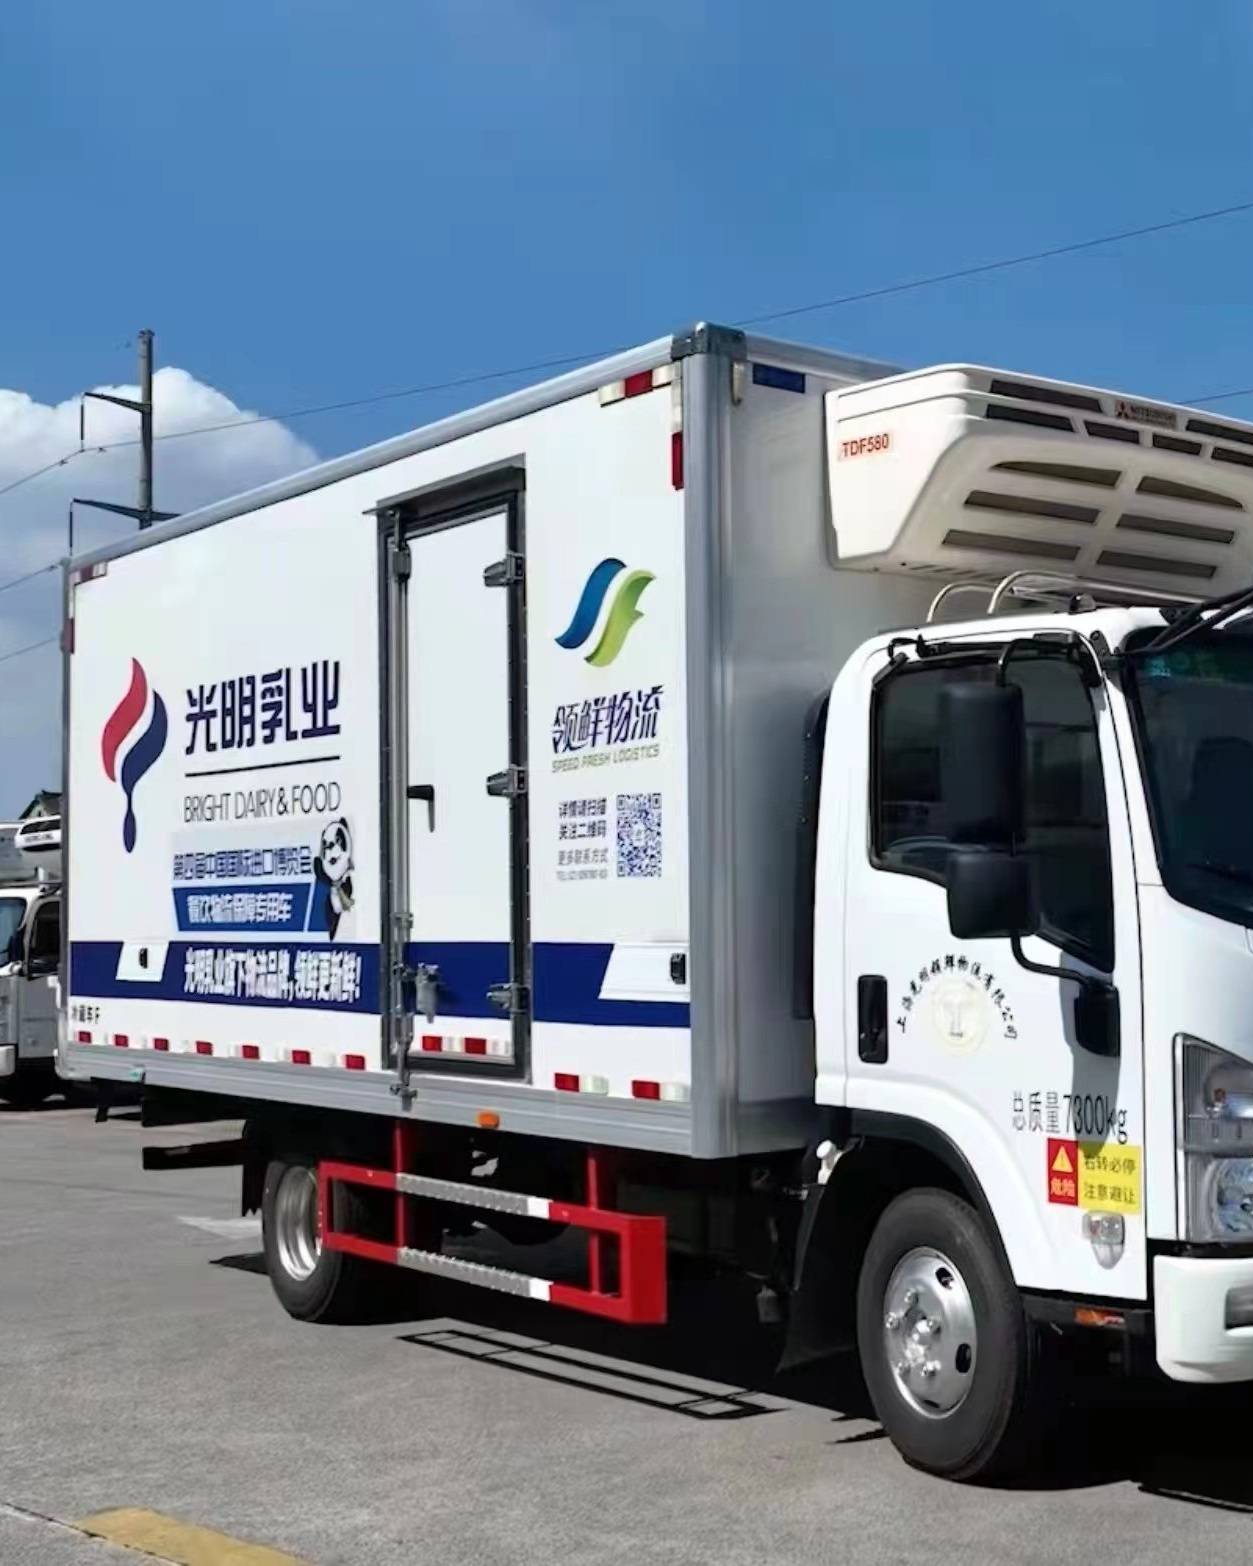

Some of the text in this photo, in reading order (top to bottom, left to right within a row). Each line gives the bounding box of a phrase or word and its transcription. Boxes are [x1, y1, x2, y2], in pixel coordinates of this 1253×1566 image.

[842, 433, 889, 457] TDF580
[185, 660, 341, 756] 光明乳业
[551, 685, 665, 754] 领鲜物流
[552, 756, 579, 773] SPEED
[613, 743, 660, 764] LOGISTICS
[184, 794, 231, 822] BRIGHT
[291, 782, 341, 815] FOOD
[1084, 1156, 1136, 1174] 右转必停
[1084, 1182, 1136, 1205] 注意避让
